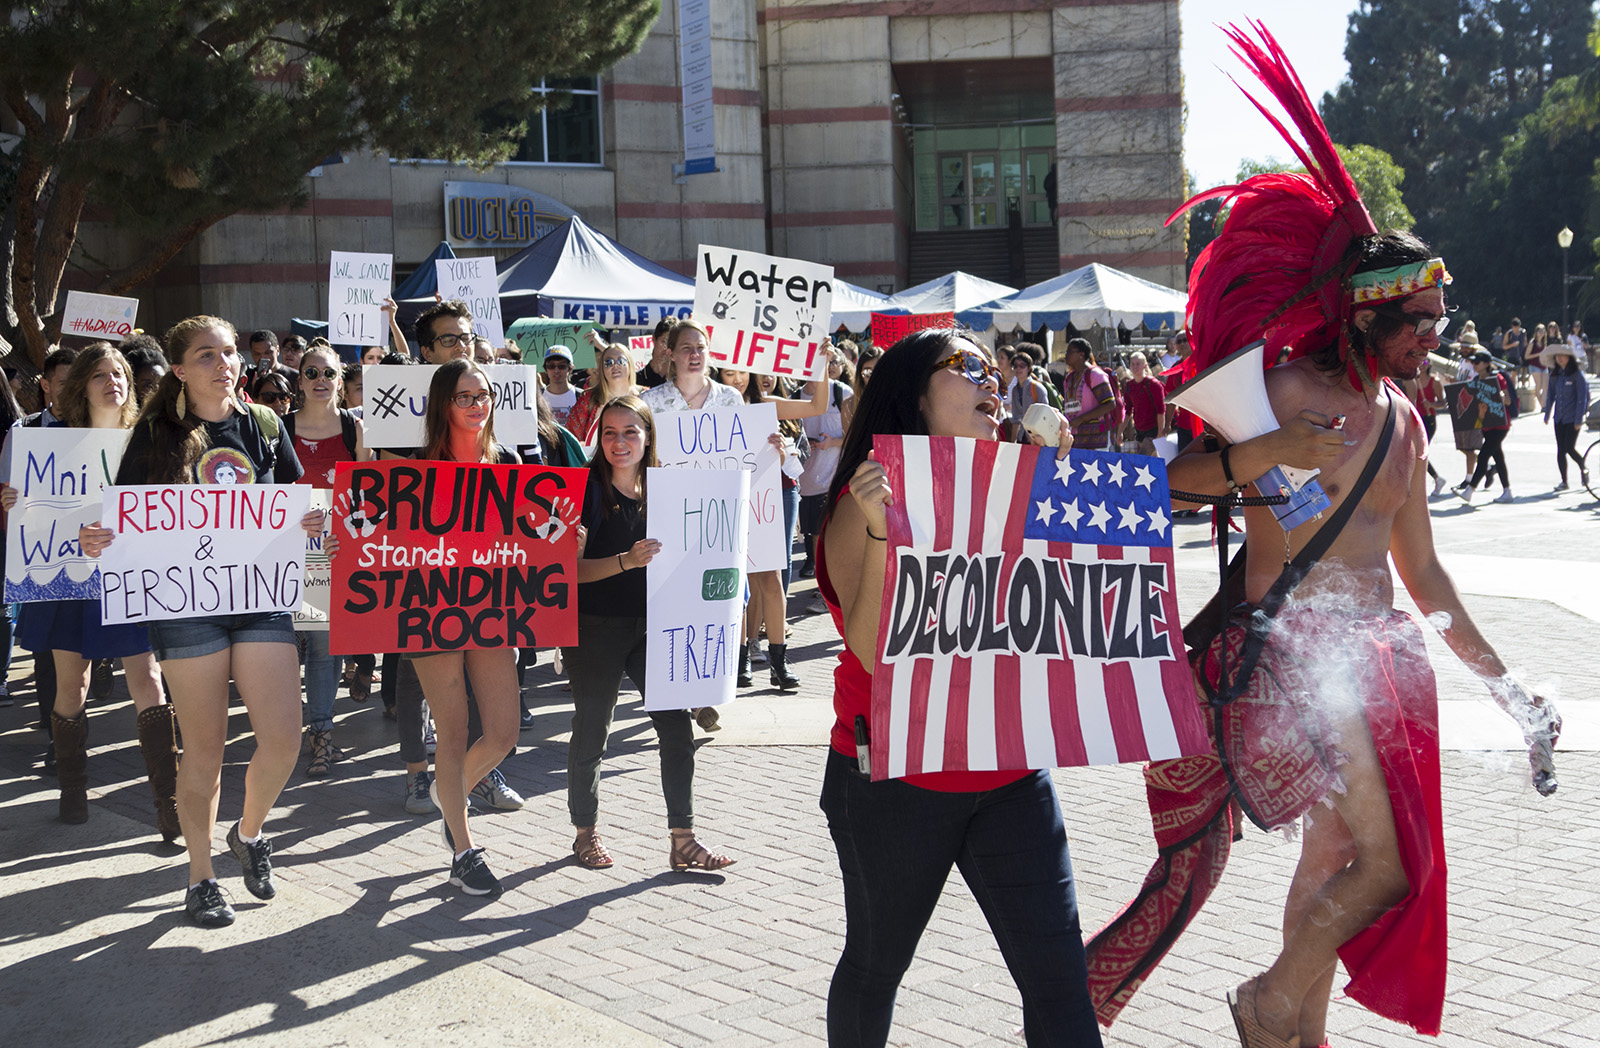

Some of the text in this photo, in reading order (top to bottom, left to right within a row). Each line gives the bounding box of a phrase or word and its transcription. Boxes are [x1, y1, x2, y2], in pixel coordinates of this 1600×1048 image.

[455, 196, 545, 240] UCLA
[1131, 226, 1157, 236] UNION
[344, 287, 380, 306] DRINK
[704, 252, 832, 309] Water
[336, 311, 375, 342] OIL
[526, 327, 552, 340] SAVE
[563, 303, 650, 326] KETTLE
[753, 299, 779, 332] is
[872, 313, 950, 330] FREE PELTIER
[705, 325, 819, 377] LIFE!
[873, 328, 899, 344] FREE
[677, 412, 749, 455] UCLA
[23, 449, 88, 498] Mni
[118, 487, 289, 534] RESISTING
[350, 465, 567, 540] BRUINS
[194, 534, 215, 561] &
[472, 541, 528, 567] with
[102, 560, 300, 620] PERSISTING
[343, 562, 569, 615] STANDING
[706, 573, 737, 598] the
[883, 550, 1173, 662] DECOLONIZE
[397, 606, 537, 650] ROCK
